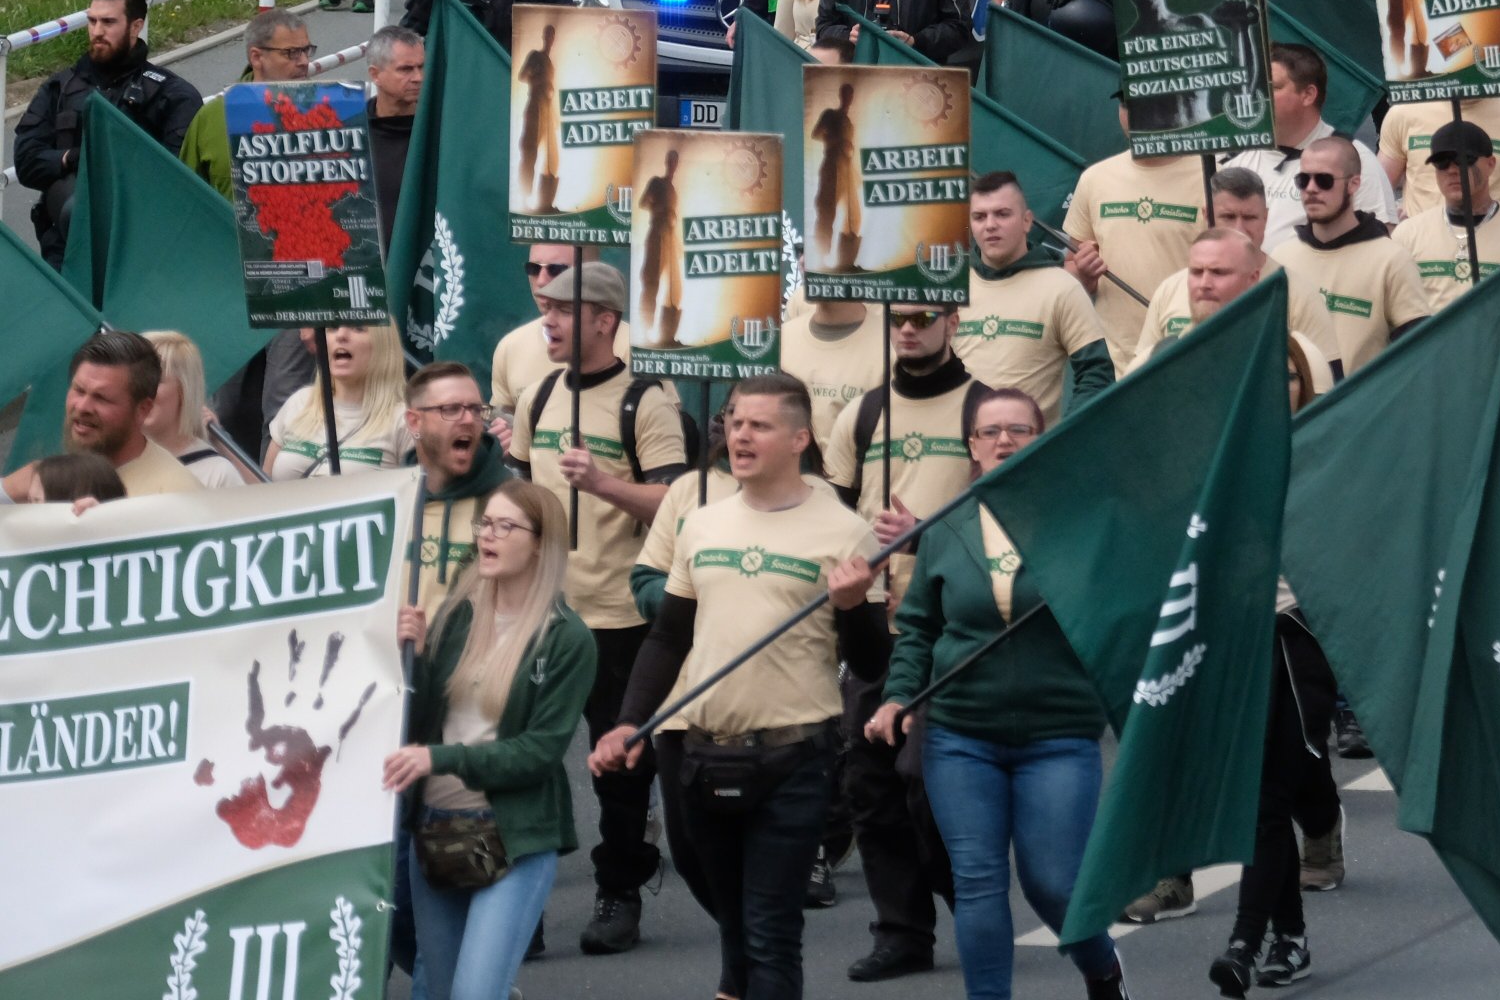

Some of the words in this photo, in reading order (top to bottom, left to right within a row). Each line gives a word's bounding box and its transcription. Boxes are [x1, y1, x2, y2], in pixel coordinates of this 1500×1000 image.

[1123, 37, 1159, 55] FÜR
[1161, 31, 1215, 50] EINEN
[1126, 51, 1229, 76] DEUTSCHEN
[1128, 70, 1248, 97] SOZIALISMUS!
[1390, 89, 1422, 102] DER
[1425, 85, 1480, 99] DRITTE
[562, 88, 654, 112] ARBEIT
[692, 104, 718, 124] DD
[235, 127, 365, 158] ASYLFLUT
[1133, 141, 1166, 155] DER
[1171, 136, 1231, 152] DRITTE
[1233, 133, 1272, 147] WEG
[864, 145, 966, 171] ARBEIT
[242, 158, 368, 183] STOPPEN!
[867, 179, 967, 203] ADELT!
[511, 217, 586, 228] www.der-dritte-weg.info
[511, 226, 544, 239] DER
[549, 228, 607, 242] DRITTE
[686, 215, 778, 241] ARBEIT
[688, 251, 779, 275] ADELT!
[807, 276, 894, 287] www.der-dritte-weg.info
[808, 284, 844, 298] DER
[851, 286, 918, 301] DRITTE
[922, 288, 965, 302] WEG
[250, 310, 386, 322] www.DER-DRITTE-WEG.info
[632, 352, 710, 362] www.der-dritte-weg.info
[632, 359, 664, 374] DER
[670, 361, 732, 378] DRITTE
[736, 364, 776, 378] WEG
[0, 511, 385, 642] CHTIGKEIT
[0, 699, 179, 777] LÄNDER!
